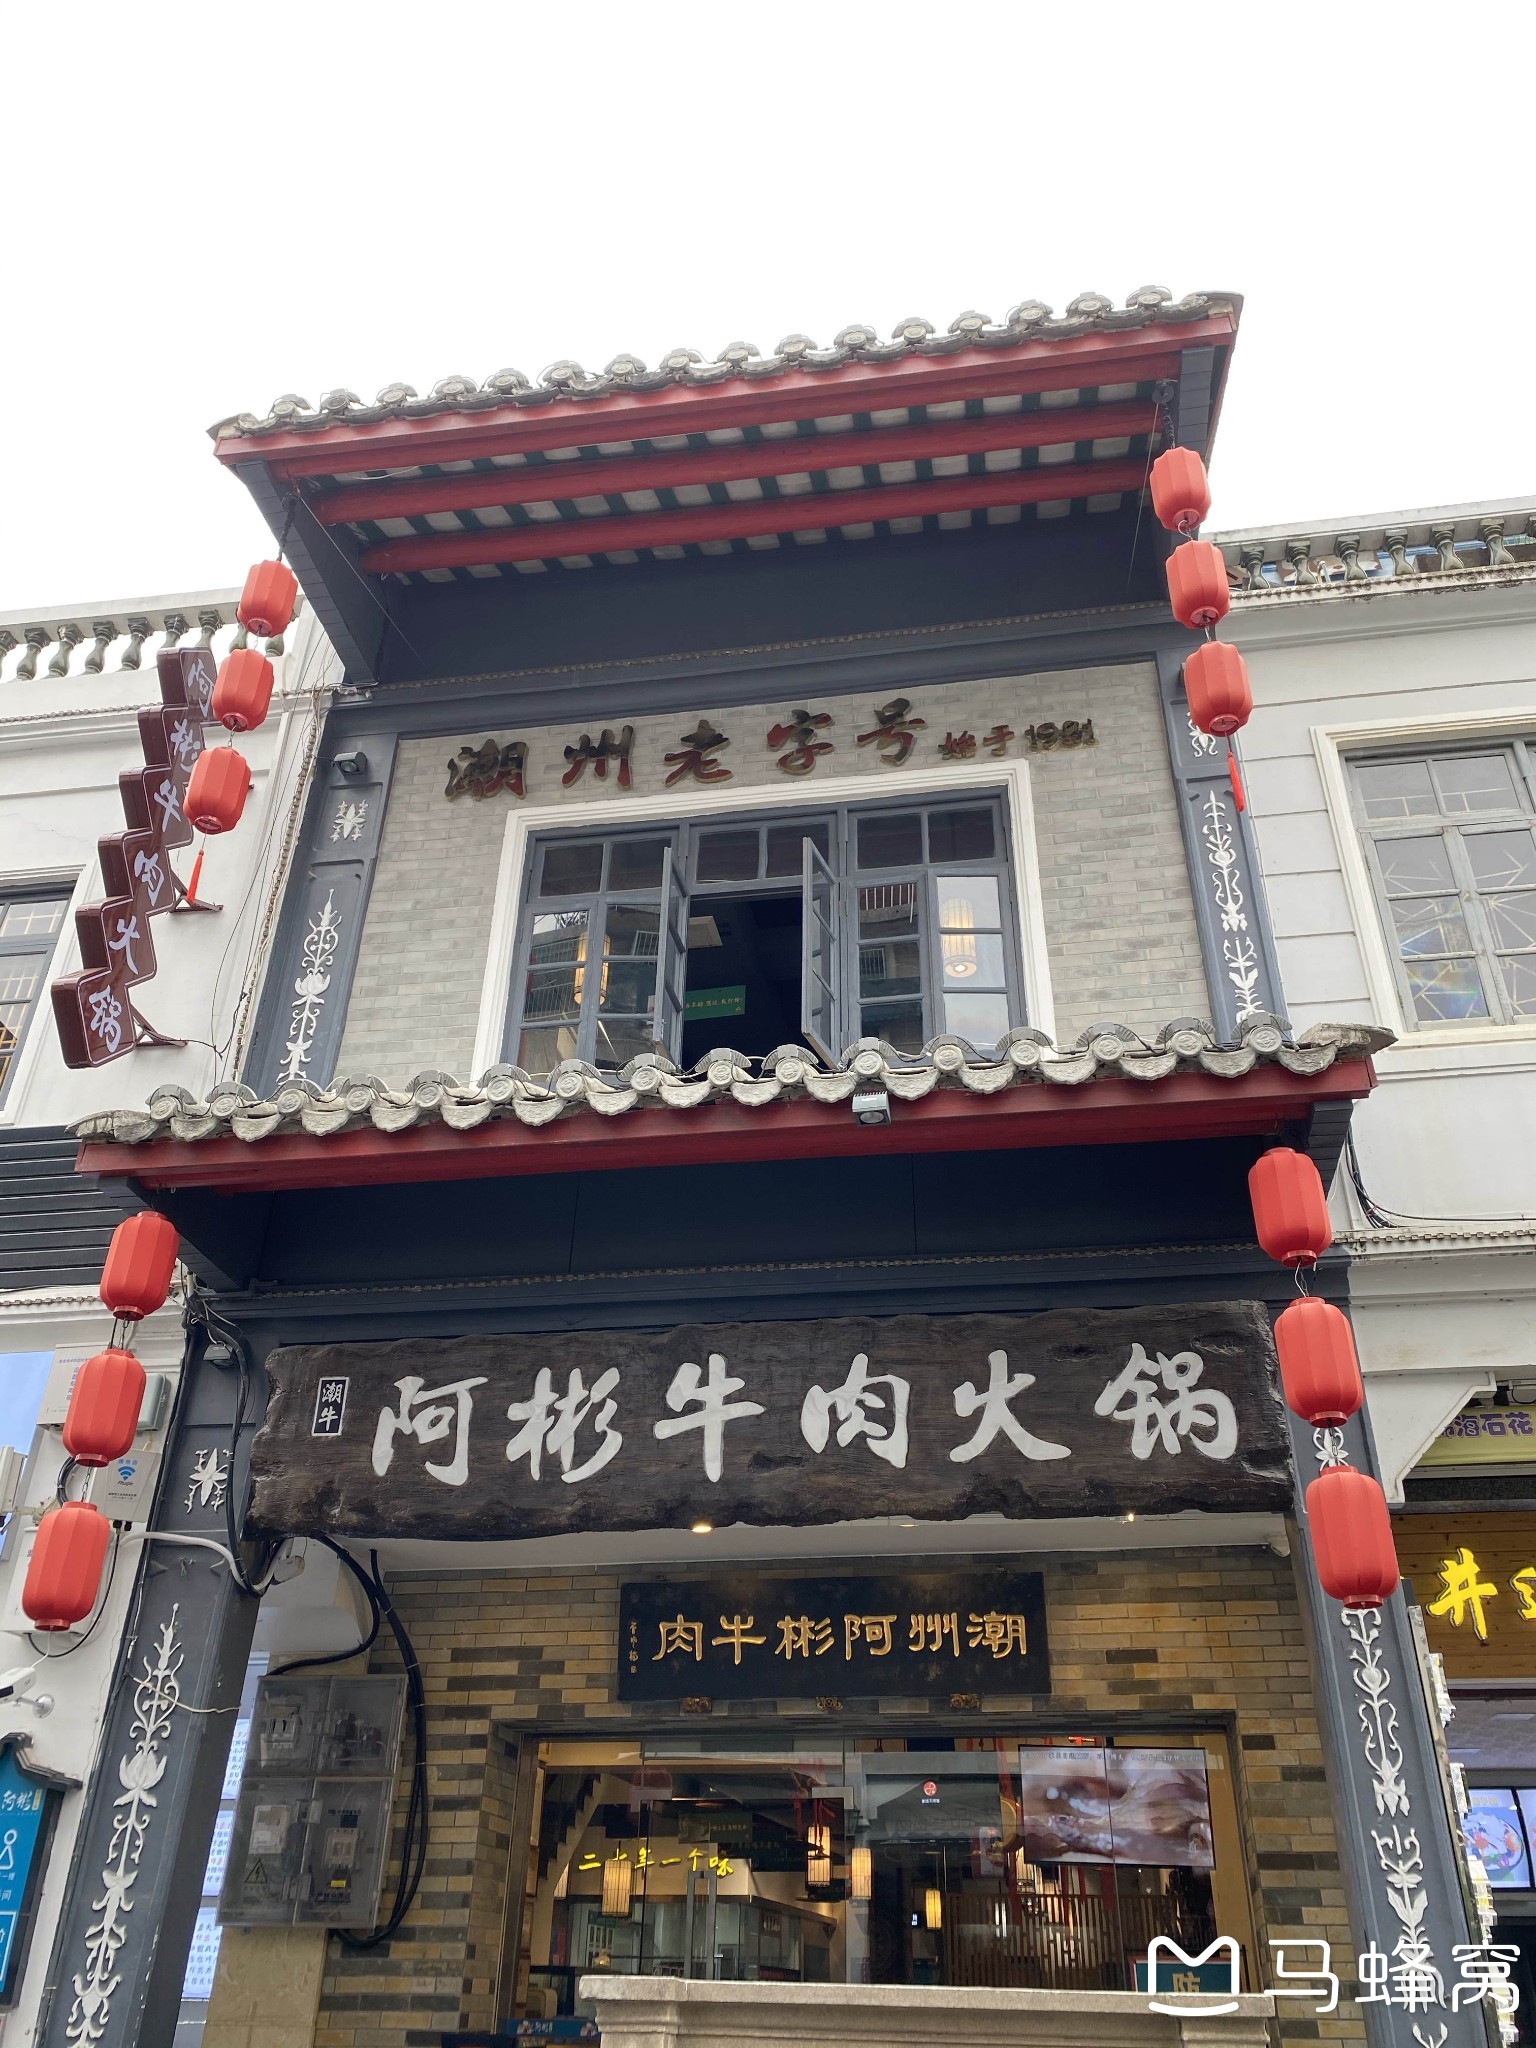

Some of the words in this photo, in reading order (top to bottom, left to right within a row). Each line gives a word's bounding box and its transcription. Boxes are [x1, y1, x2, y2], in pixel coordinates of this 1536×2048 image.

[445, 697, 928, 800] 潮州老字号
[317, 1381, 344, 1432] 潮牛
[371, 1341, 1241, 1487] 阿彬牛肉火锅
[652, 1610, 1029, 1666] 潮州阿彬牛肉
